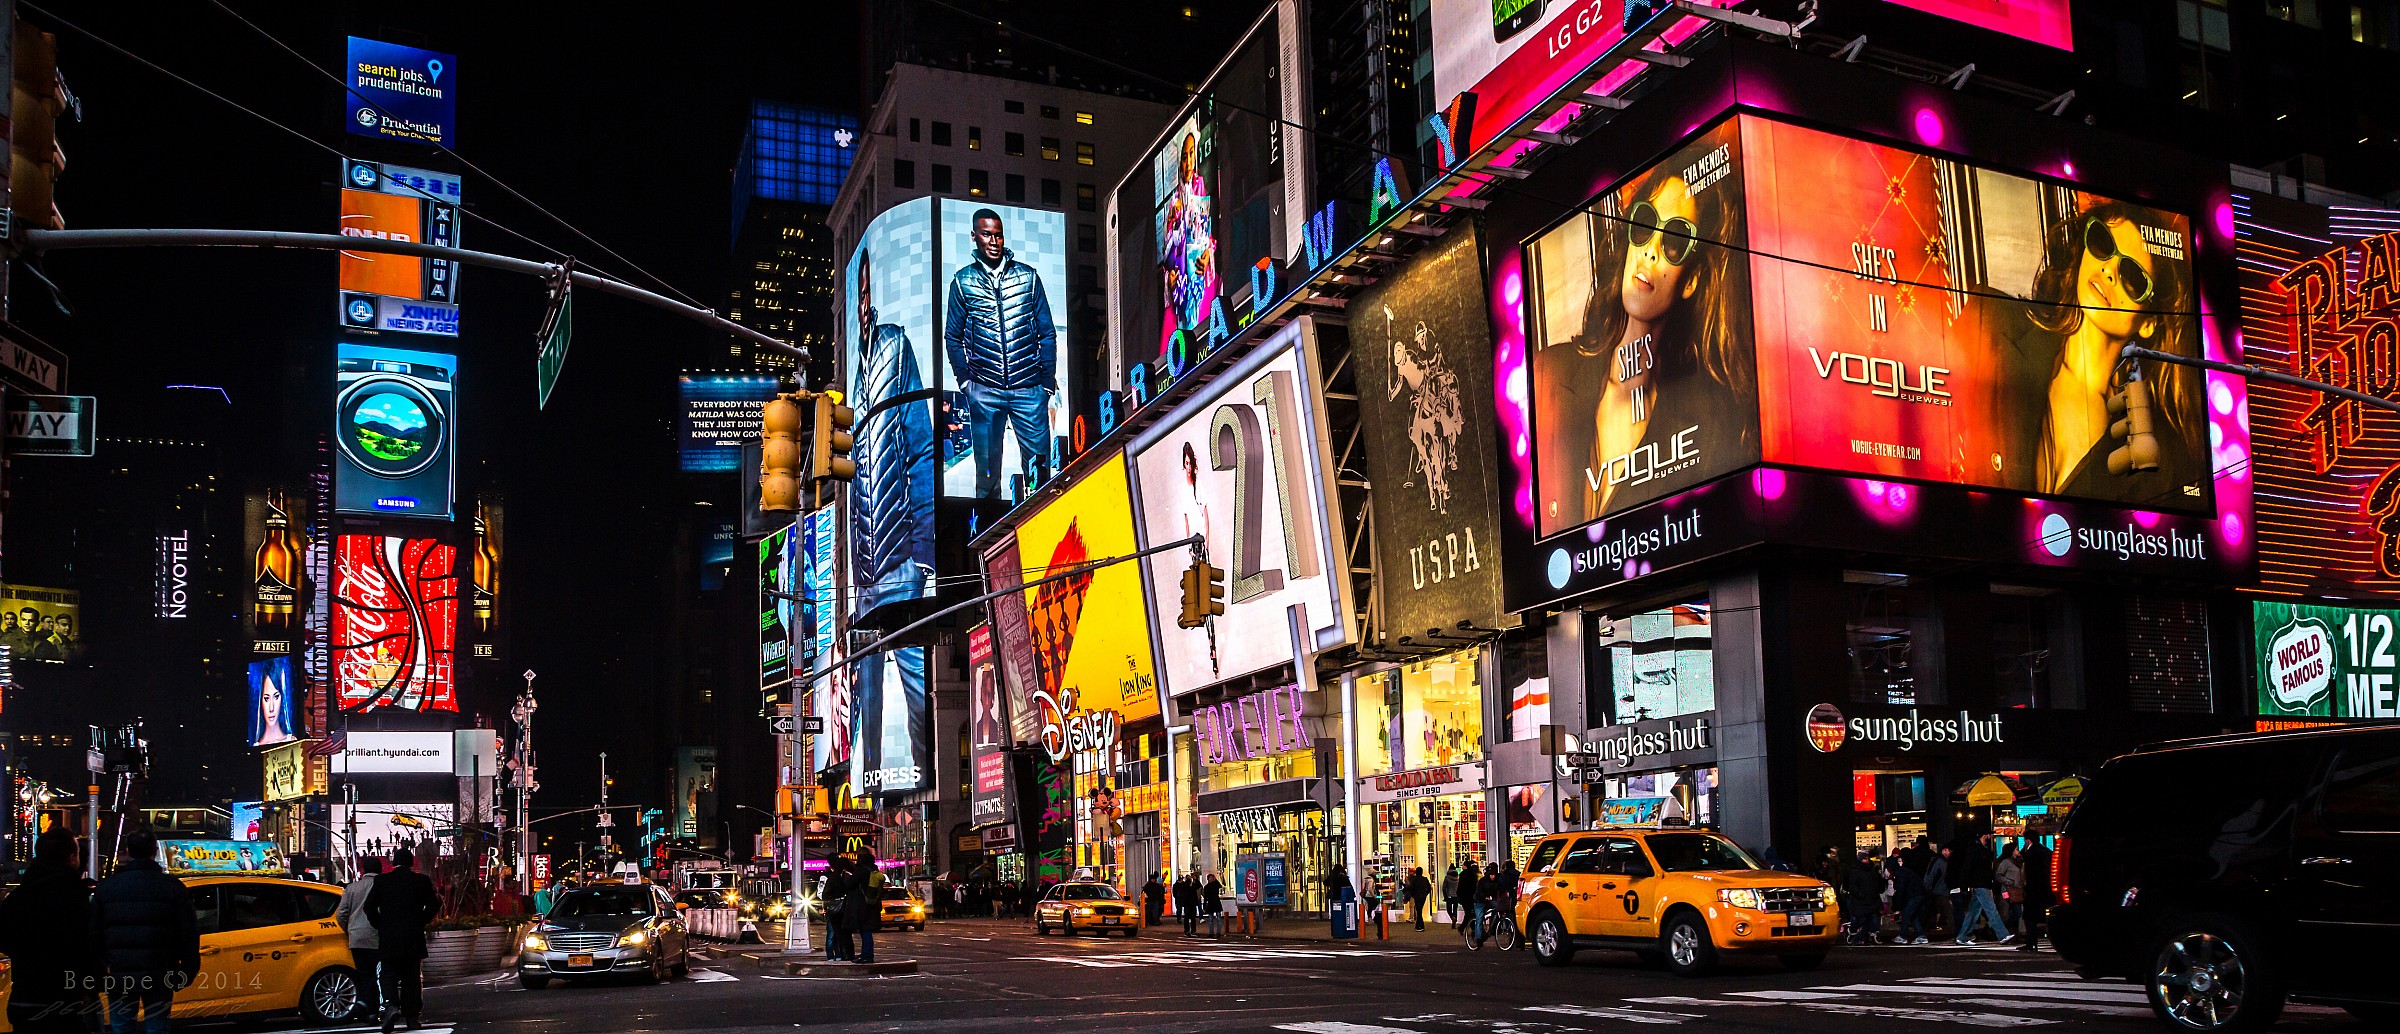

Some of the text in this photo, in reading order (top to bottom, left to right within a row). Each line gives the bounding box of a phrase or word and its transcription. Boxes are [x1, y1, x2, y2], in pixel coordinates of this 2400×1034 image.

[1548, 0, 1604, 60] LG G2
[358, 62, 427, 84] search jobs.
[358, 75, 442, 100] prudential.com
[380, 114, 441, 136] Prudential
[380, 127, 396, 137] Bring
[1683, 142, 1730, 187] EVA MENDES
[1706, 162, 1731, 187] EYEWEAR
[2140, 224, 2183, 249] EVA MENDES
[1100, 91, 1477, 436] BROADWAY
[1852, 241, 1898, 286] SHE'S
[2161, 246, 2184, 261] EYEWEAR
[1868, 293, 1888, 333] IN
[2278, 231, 2400, 379] PLA
[387, 317, 424, 331] NEWS
[13, 345, 50, 384] WAY
[1617, 333, 1654, 383] SHE'S
[1630, 385, 1646, 424] IN
[1900, 392, 1953, 407] eyewear
[7, 412, 66, 437] WAY
[691, 430, 762, 439] KNOW HOW GOO
[692, 420, 764, 429] THEY JUST DIDN'T
[1009, 414, 1085, 507] 1540
[1851, 439, 1921, 461] VOGUE-EYEWEAR.COM
[1653, 456, 1701, 480] eyewear
[1209, 371, 1320, 605] 21
[377, 498, 415, 508] SAMSUNG
[1576, 508, 1702, 573] sunglass hut
[2077, 523, 2206, 561] sunglass hut
[1409, 526, 1480, 591] USPA
[1, 587, 14, 599] THE
[16, 589, 62, 603] MONUMENTS
[2277, 633, 2321, 671] WORLD
[2343, 612, 2396, 668] 1/2
[1127, 658, 1137, 669] THE
[2281, 657, 2324, 694] FAMOUS
[1118, 677, 1135, 702] LION
[1134, 671, 1152, 697] KING
[780, 721, 793, 730] ON
[1192, 681, 1310, 768] FOREVER
[1849, 708, 2004, 752] sunglass hut
[346, 747, 440, 759] brilliant.hyundai.com
[1582, 717, 1710, 768] sunglass hut
[864, 765, 922, 788] EXPRESS
[1396, 786, 1441, 798] SINCE 1890
[1219, 806, 1280, 835] FOREVER 21
[1608, 803, 1636, 815] NUT JOB
[184, 849, 238, 861] NUT JOB
[536, 856, 548, 879] tkts
